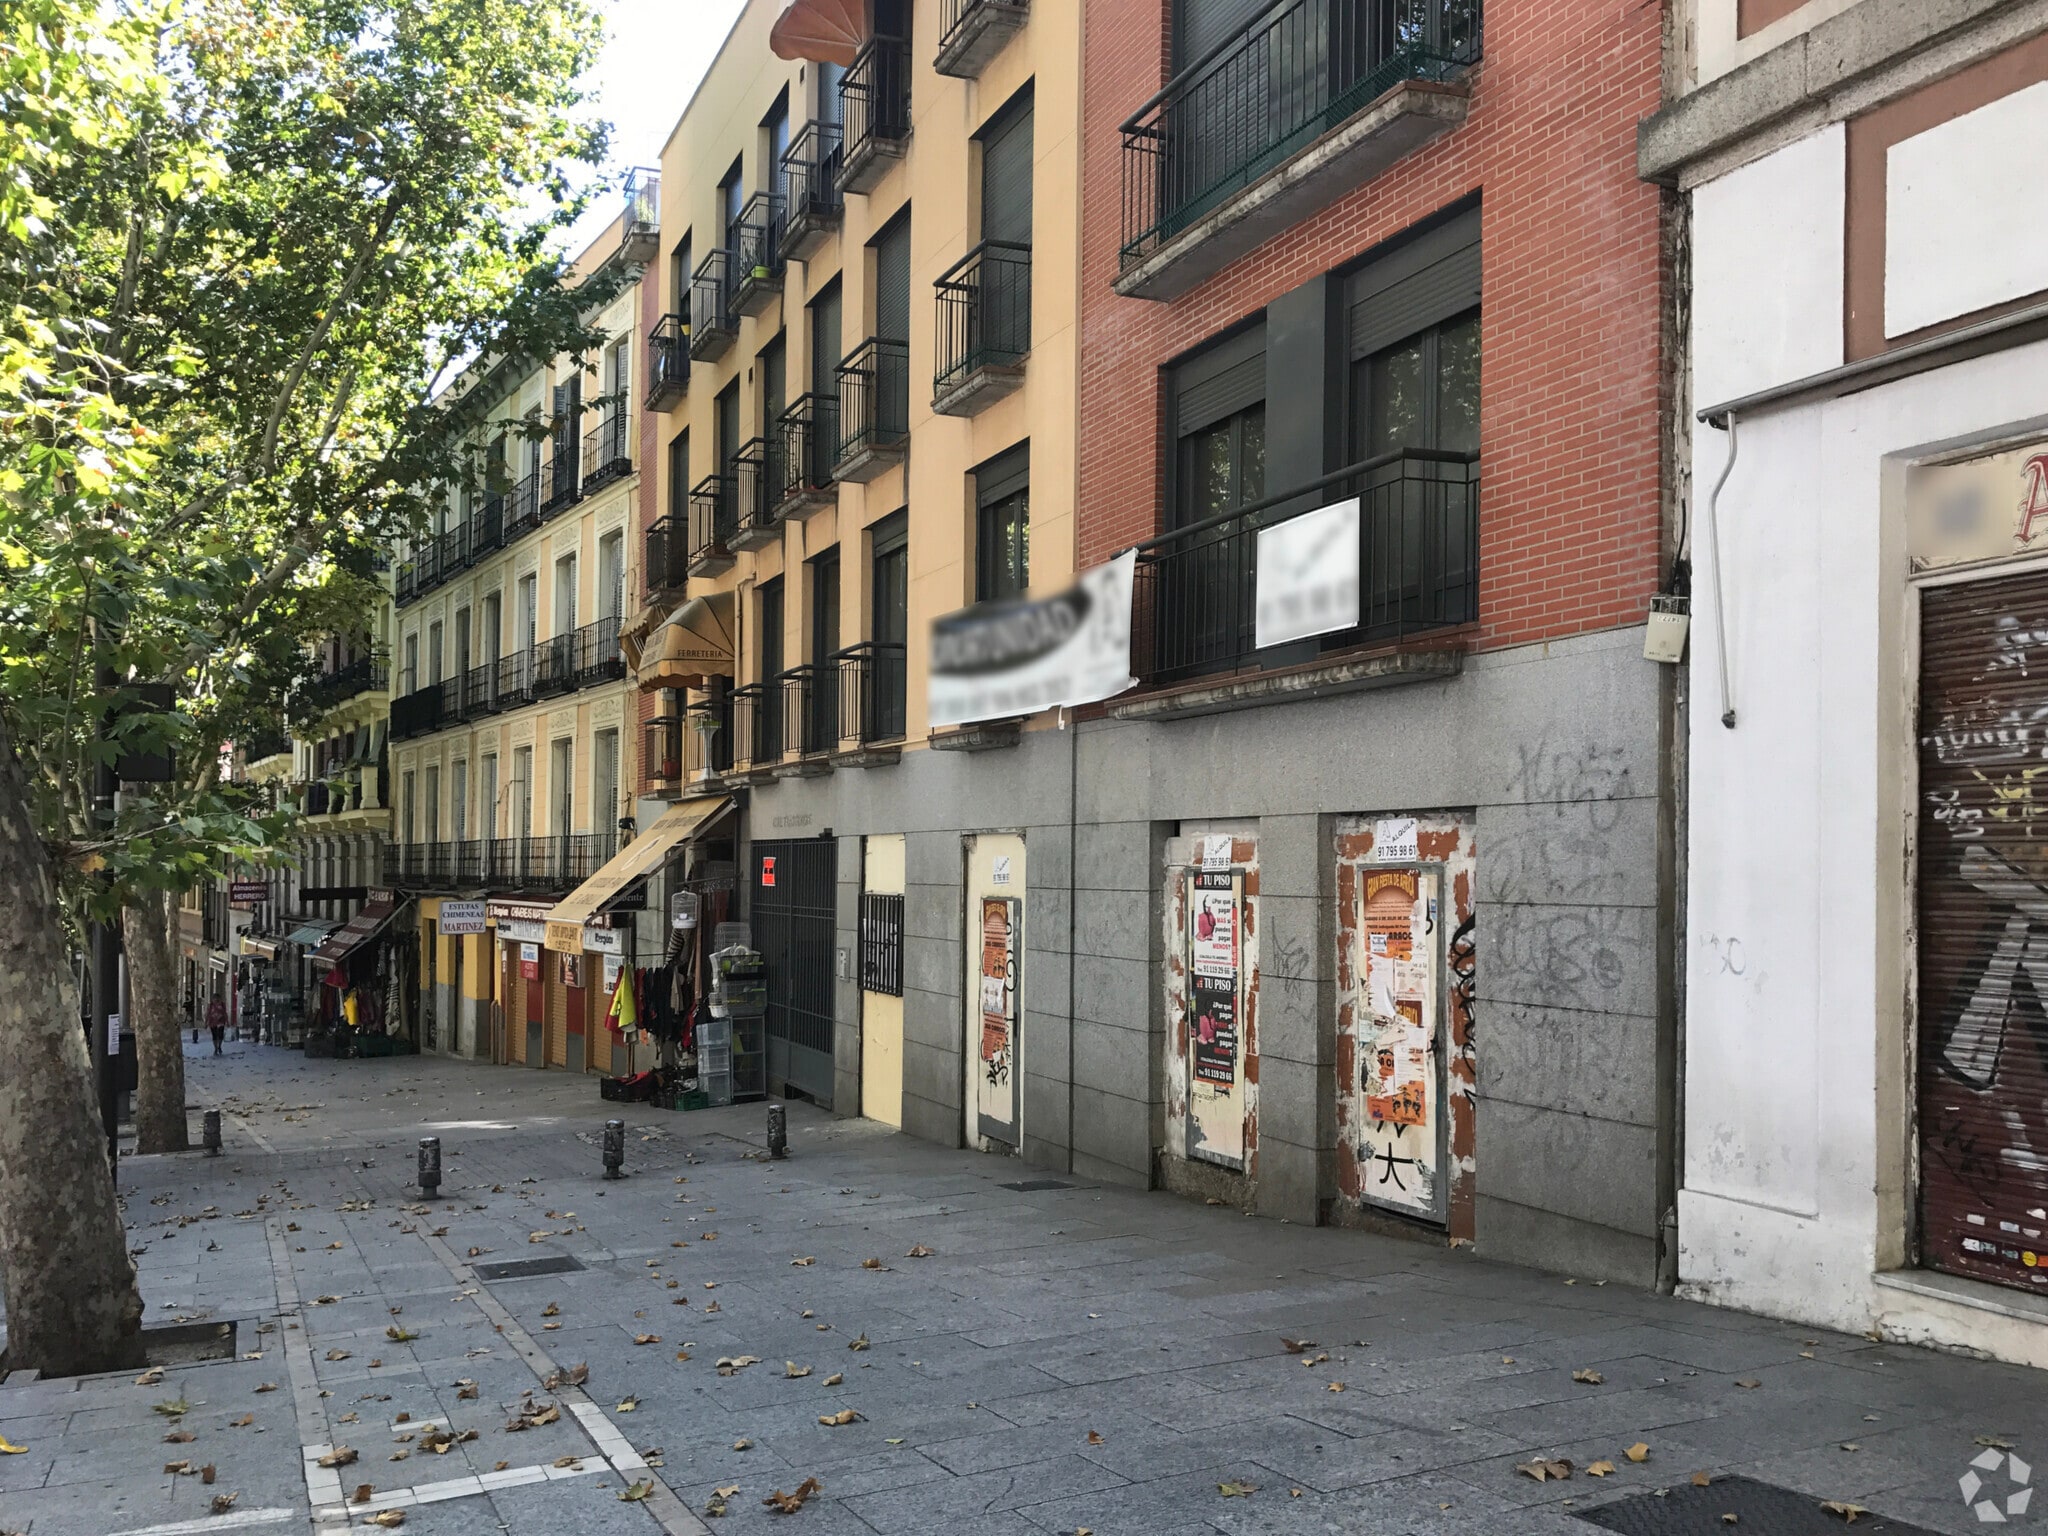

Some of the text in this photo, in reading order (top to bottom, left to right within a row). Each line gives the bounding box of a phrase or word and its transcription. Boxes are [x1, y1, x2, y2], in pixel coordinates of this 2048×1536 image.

[678, 650, 722, 658] FERRETERIA
[1392, 820, 1415, 842] ALQUILA
[1378, 845, 1416, 856] 91 795 98 61
[1203, 875, 1230, 886] TU PISO
[444, 921, 484, 931] MARTINEZ
[1204, 978, 1231, 991] TU PISO
[1205, 1068, 1210, 1076] 91
[1220, 1071, 1225, 1079] 29
